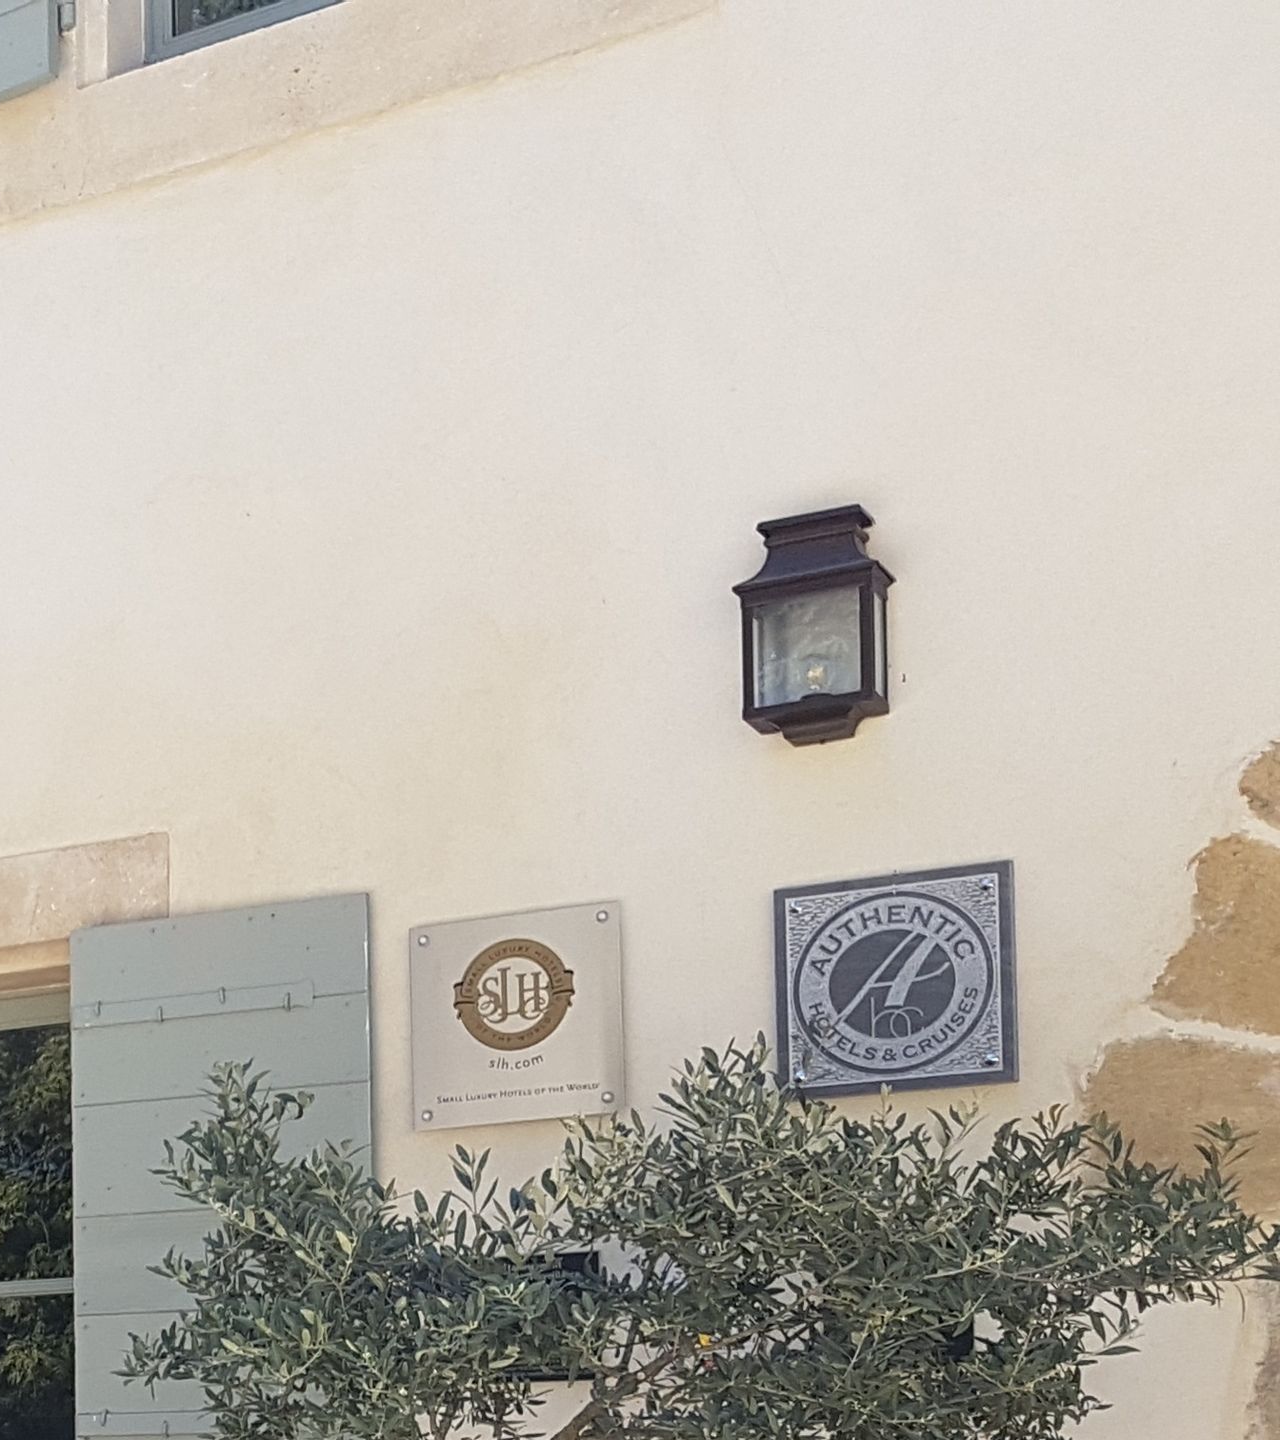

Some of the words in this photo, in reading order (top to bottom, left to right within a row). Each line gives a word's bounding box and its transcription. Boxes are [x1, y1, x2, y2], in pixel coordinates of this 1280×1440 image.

[809, 904, 976, 977] AUTHENTIC
[809, 1002, 878, 1061] HOTELS
[882, 1048, 897, 1062] &
[902, 986, 978, 1059] CRUISES
[488, 1054, 544, 1071] slh.com
